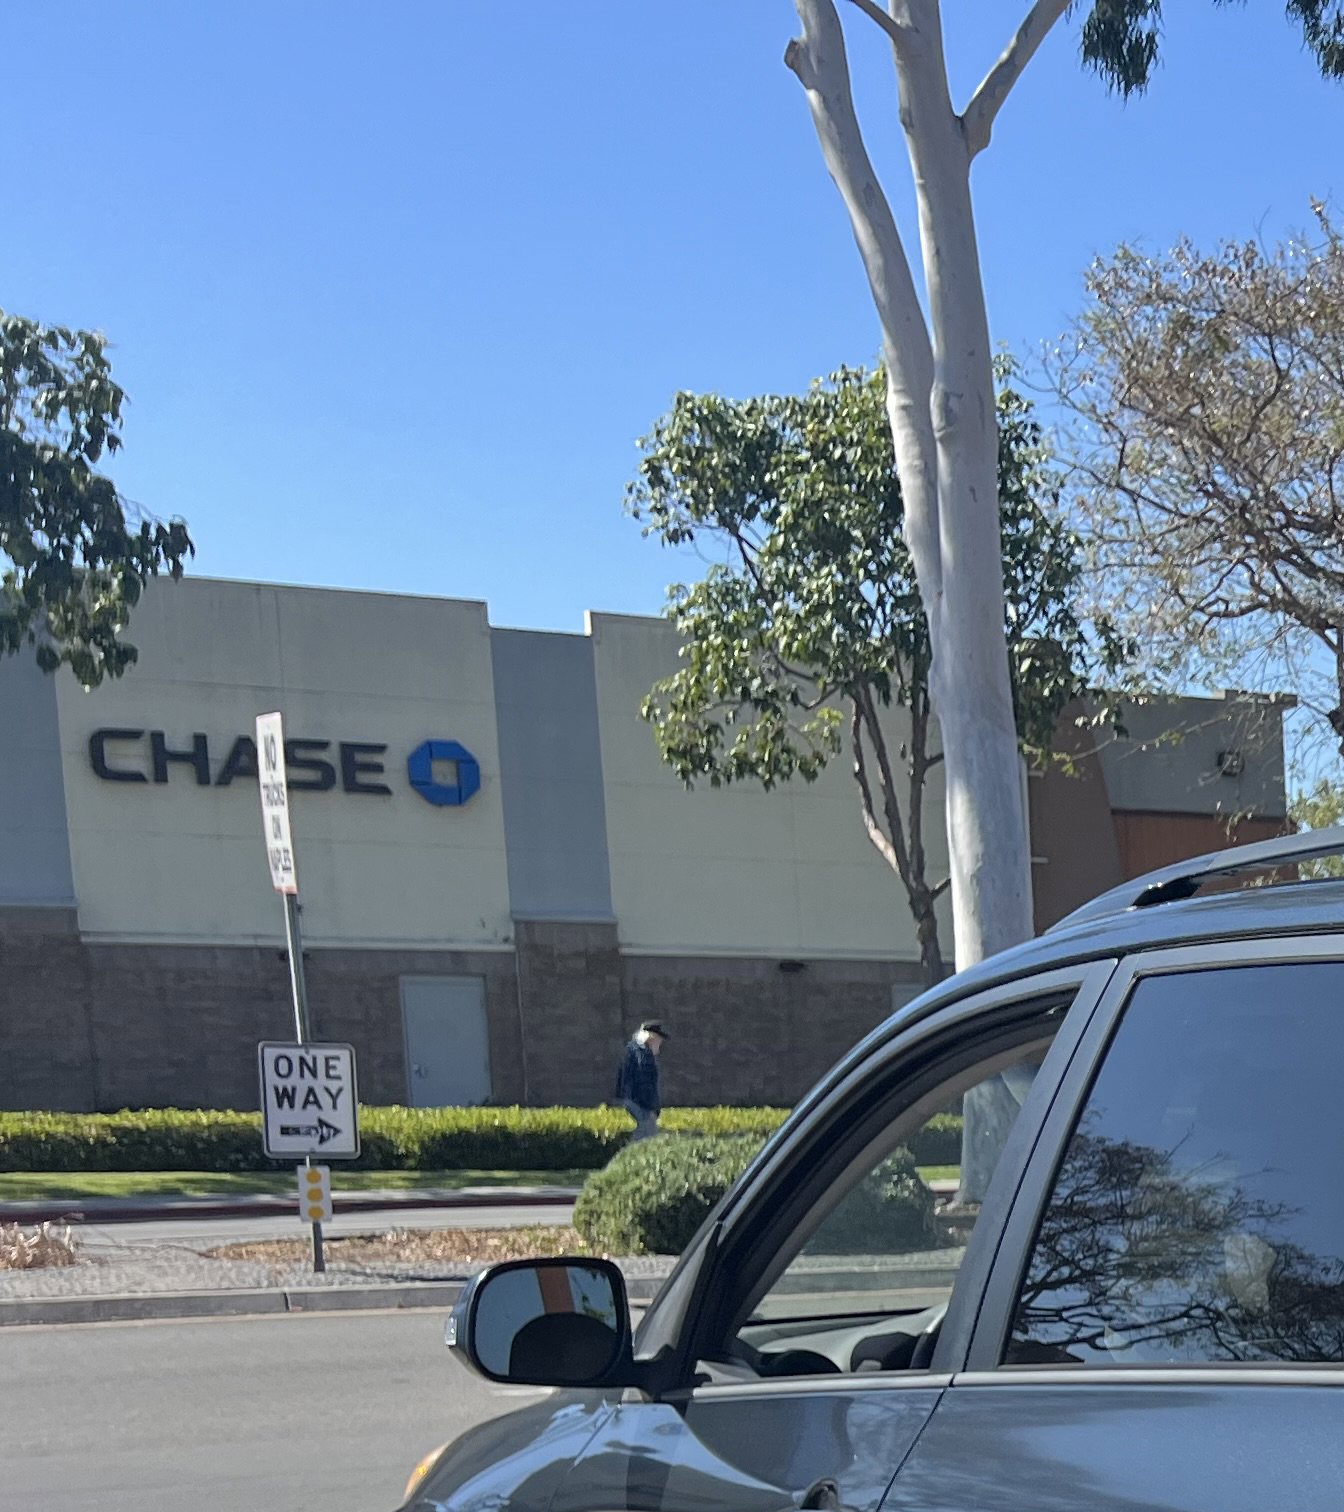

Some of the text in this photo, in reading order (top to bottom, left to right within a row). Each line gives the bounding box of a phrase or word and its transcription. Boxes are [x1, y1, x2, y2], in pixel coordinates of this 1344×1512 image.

[89, 727, 392, 795] CHASE
[273, 1053, 343, 1080] ONE
[273, 1084, 344, 1112] WAY
